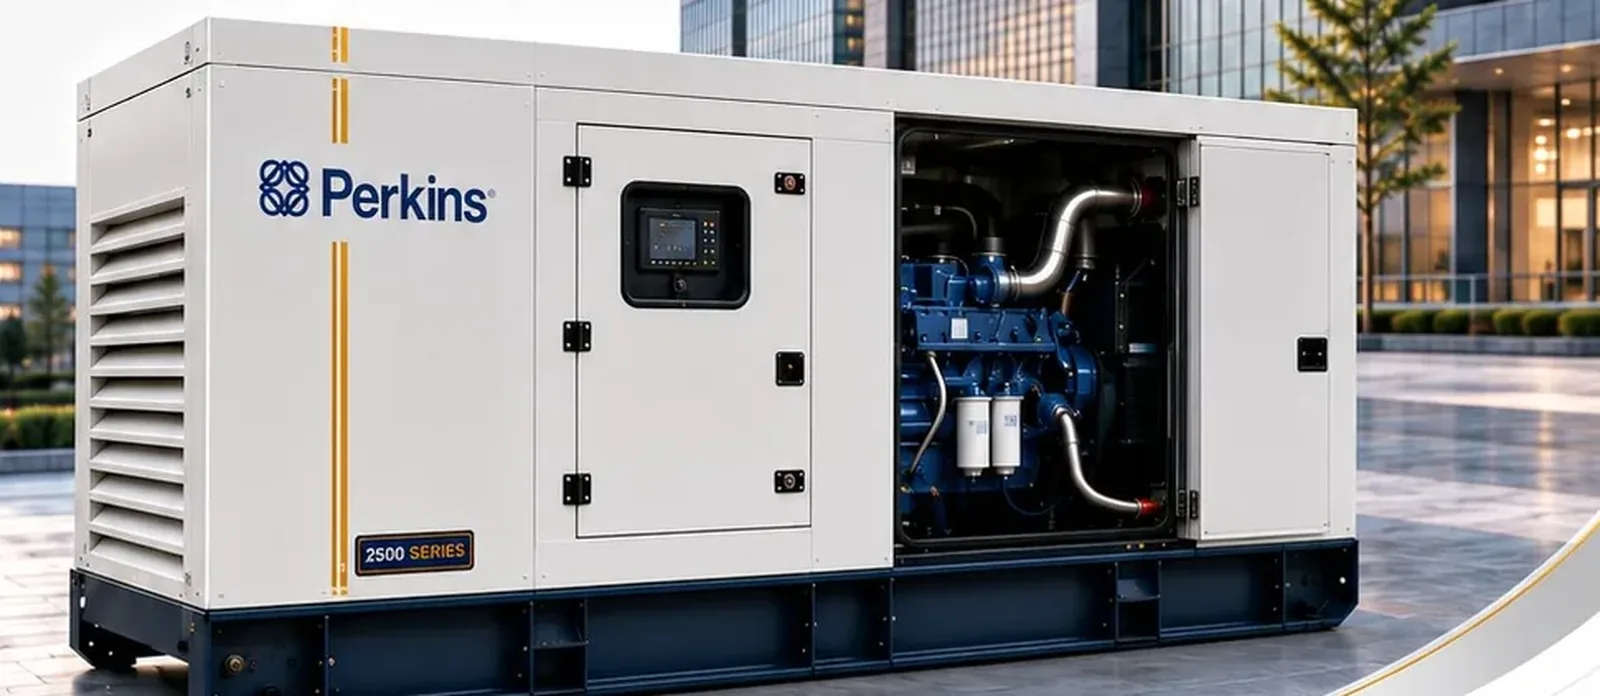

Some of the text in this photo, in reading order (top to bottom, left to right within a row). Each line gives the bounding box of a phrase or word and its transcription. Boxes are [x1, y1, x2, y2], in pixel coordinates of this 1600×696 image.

[322, 167, 487, 223] Perkins
[365, 543, 465, 563] 2500 SERIES
